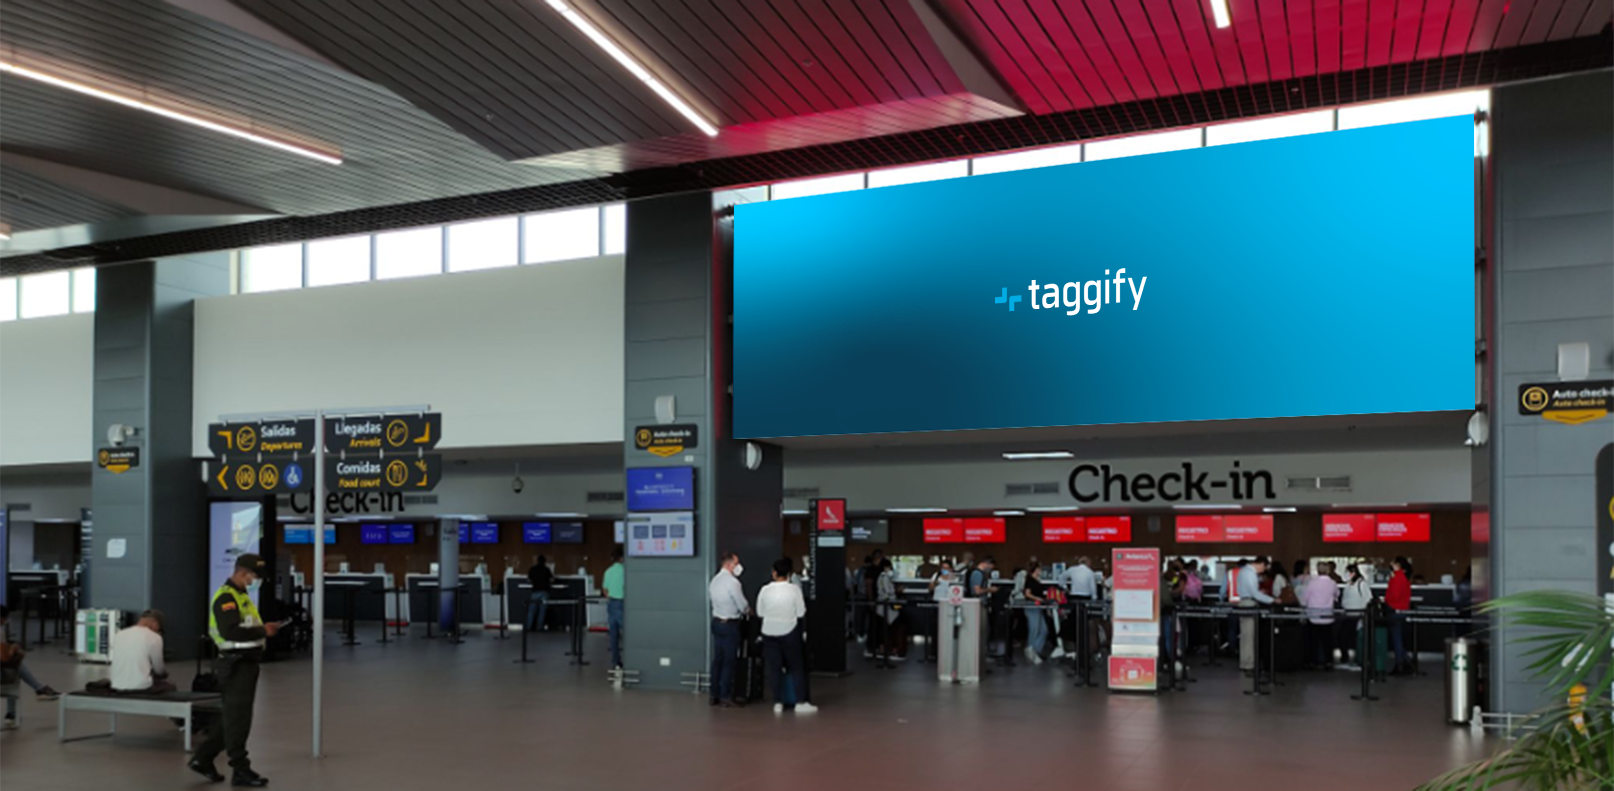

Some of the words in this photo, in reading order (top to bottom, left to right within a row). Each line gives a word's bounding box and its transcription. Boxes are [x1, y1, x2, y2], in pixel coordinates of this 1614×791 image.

[1028, 268, 1148, 316] taggify
[1552, 390, 1578, 399] Auto
[1572, 399, 1606, 407] check-in
[261, 424, 296, 438] Salidas
[335, 422, 382, 437] Llegadas
[260, 440, 303, 452] Departures
[350, 437, 382, 447] Arrivals
[336, 462, 381, 474] Comidas
[338, 478, 358, 488] Food
[360, 477, 381, 488] court
[1068, 461, 1276, 502] Check-in
